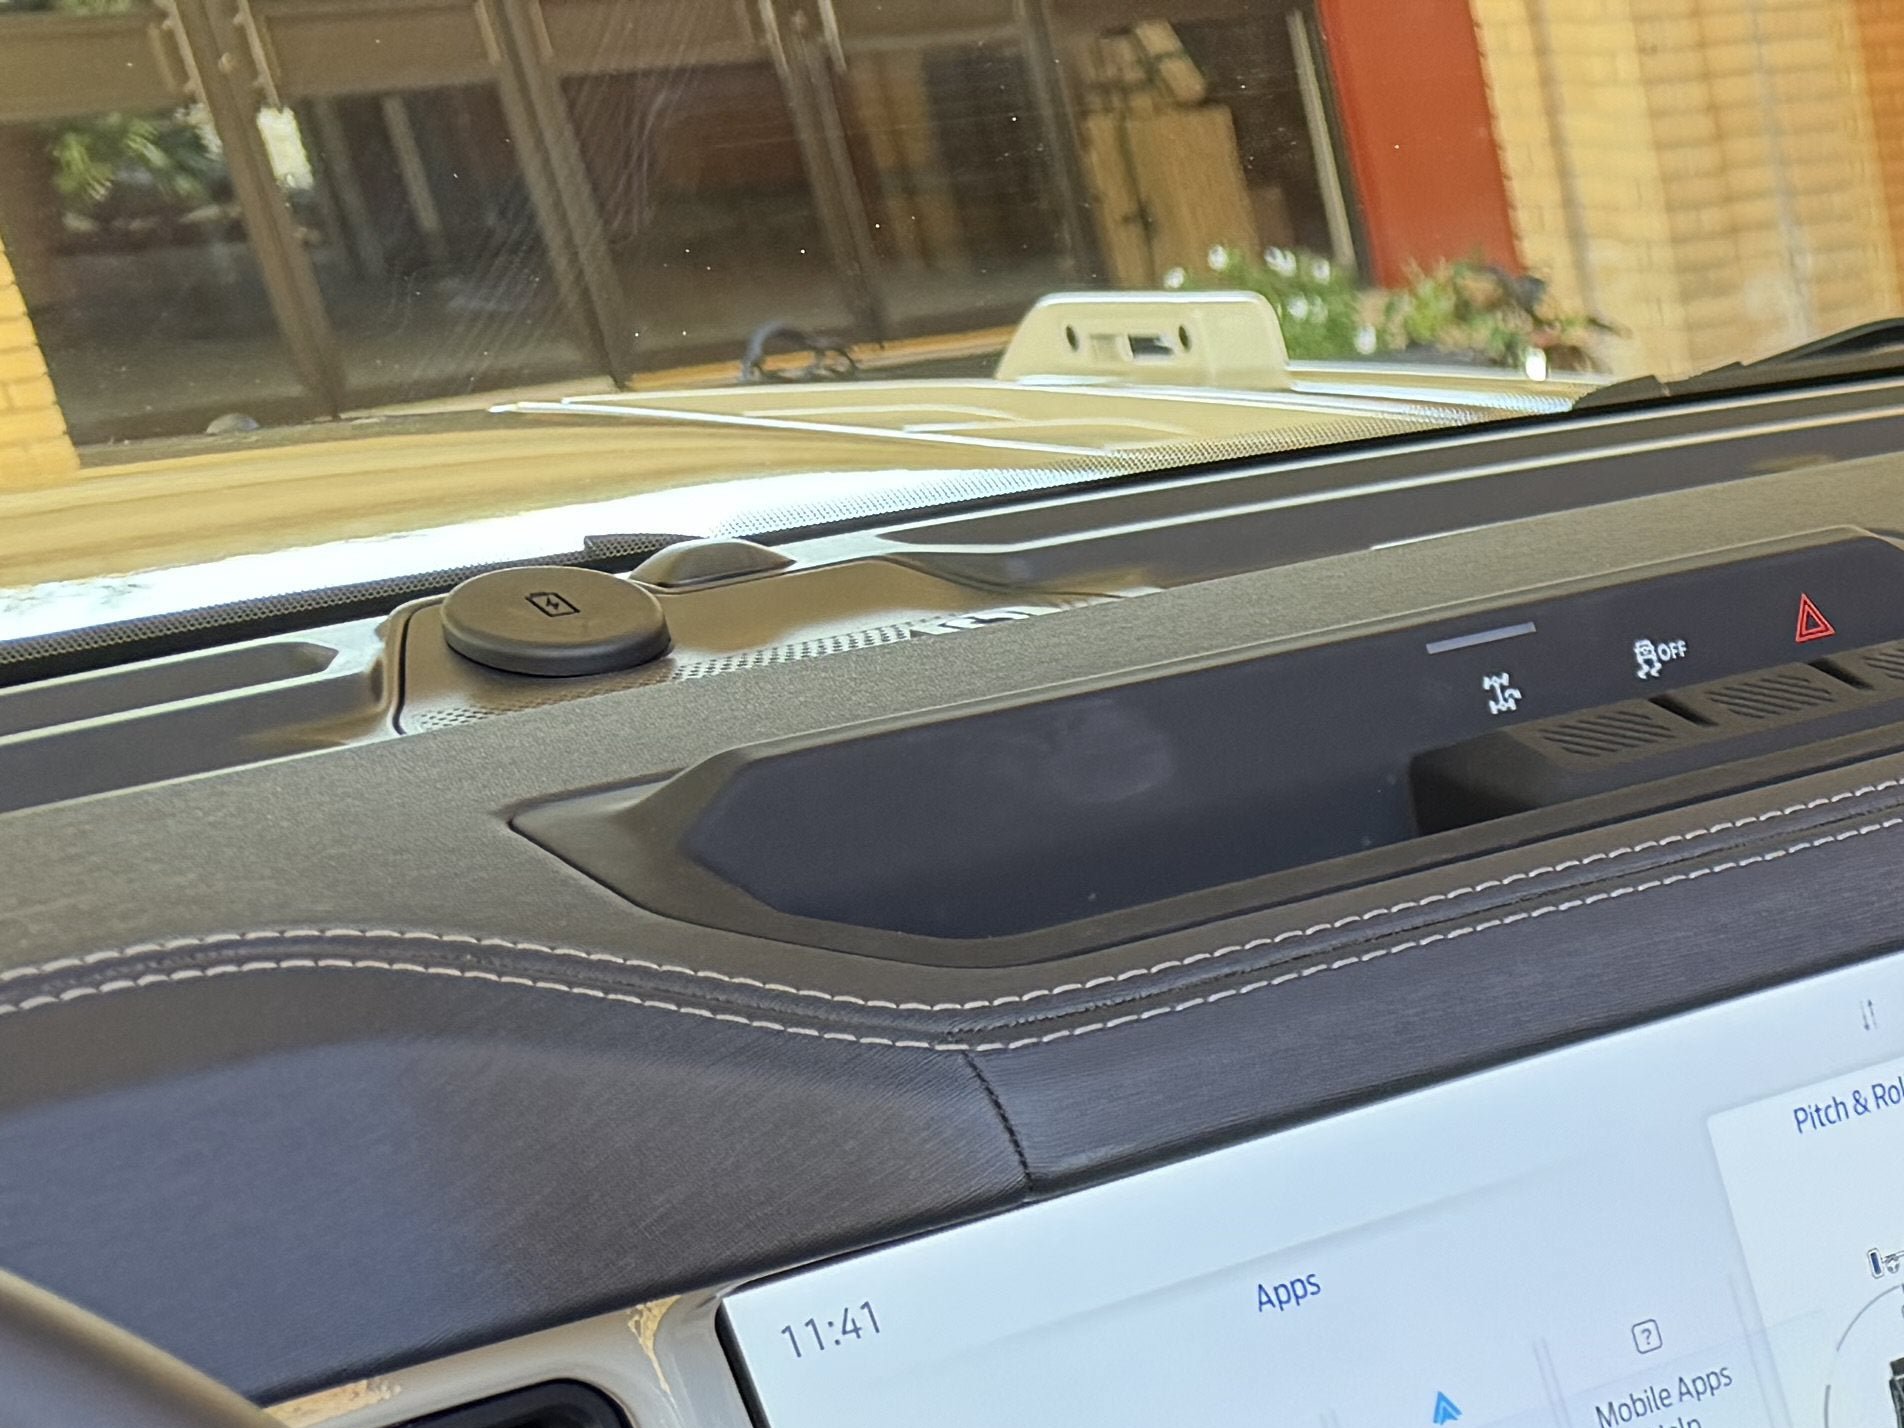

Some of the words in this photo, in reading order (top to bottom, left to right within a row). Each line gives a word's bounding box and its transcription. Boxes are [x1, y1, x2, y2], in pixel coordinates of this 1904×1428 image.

[1659, 639, 1688, 663] OFF
[1793, 1096, 1849, 1135] Pitch
[1851, 1088, 1871, 1116] &
[1256, 1272, 1322, 1313] Apps
[782, 1300, 881, 1358] 11:41
[1674, 1363, 1734, 1406] Apps
